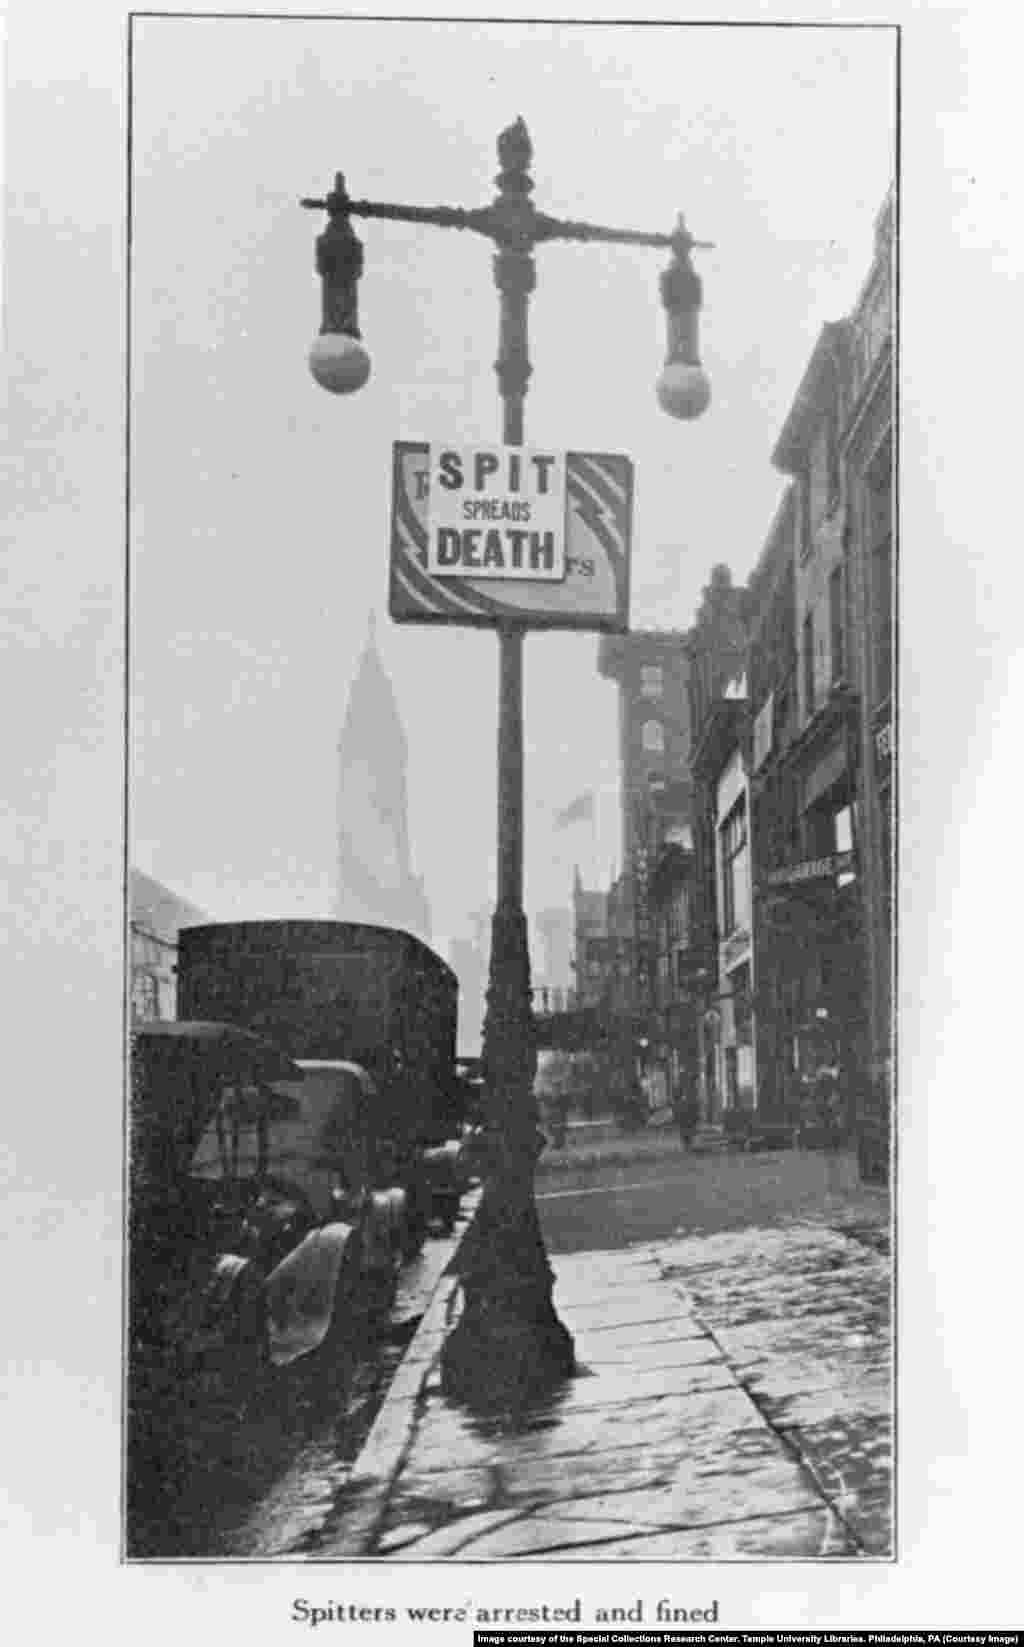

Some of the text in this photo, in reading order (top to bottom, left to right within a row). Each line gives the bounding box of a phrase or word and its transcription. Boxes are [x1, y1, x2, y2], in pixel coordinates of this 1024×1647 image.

[439, 451, 555, 494] SPIT
[463, 499, 532, 521] SPREADS
[436, 527, 554, 569] DEATH
[291, 1599, 719, 1626] Spitters were arrested and fined
